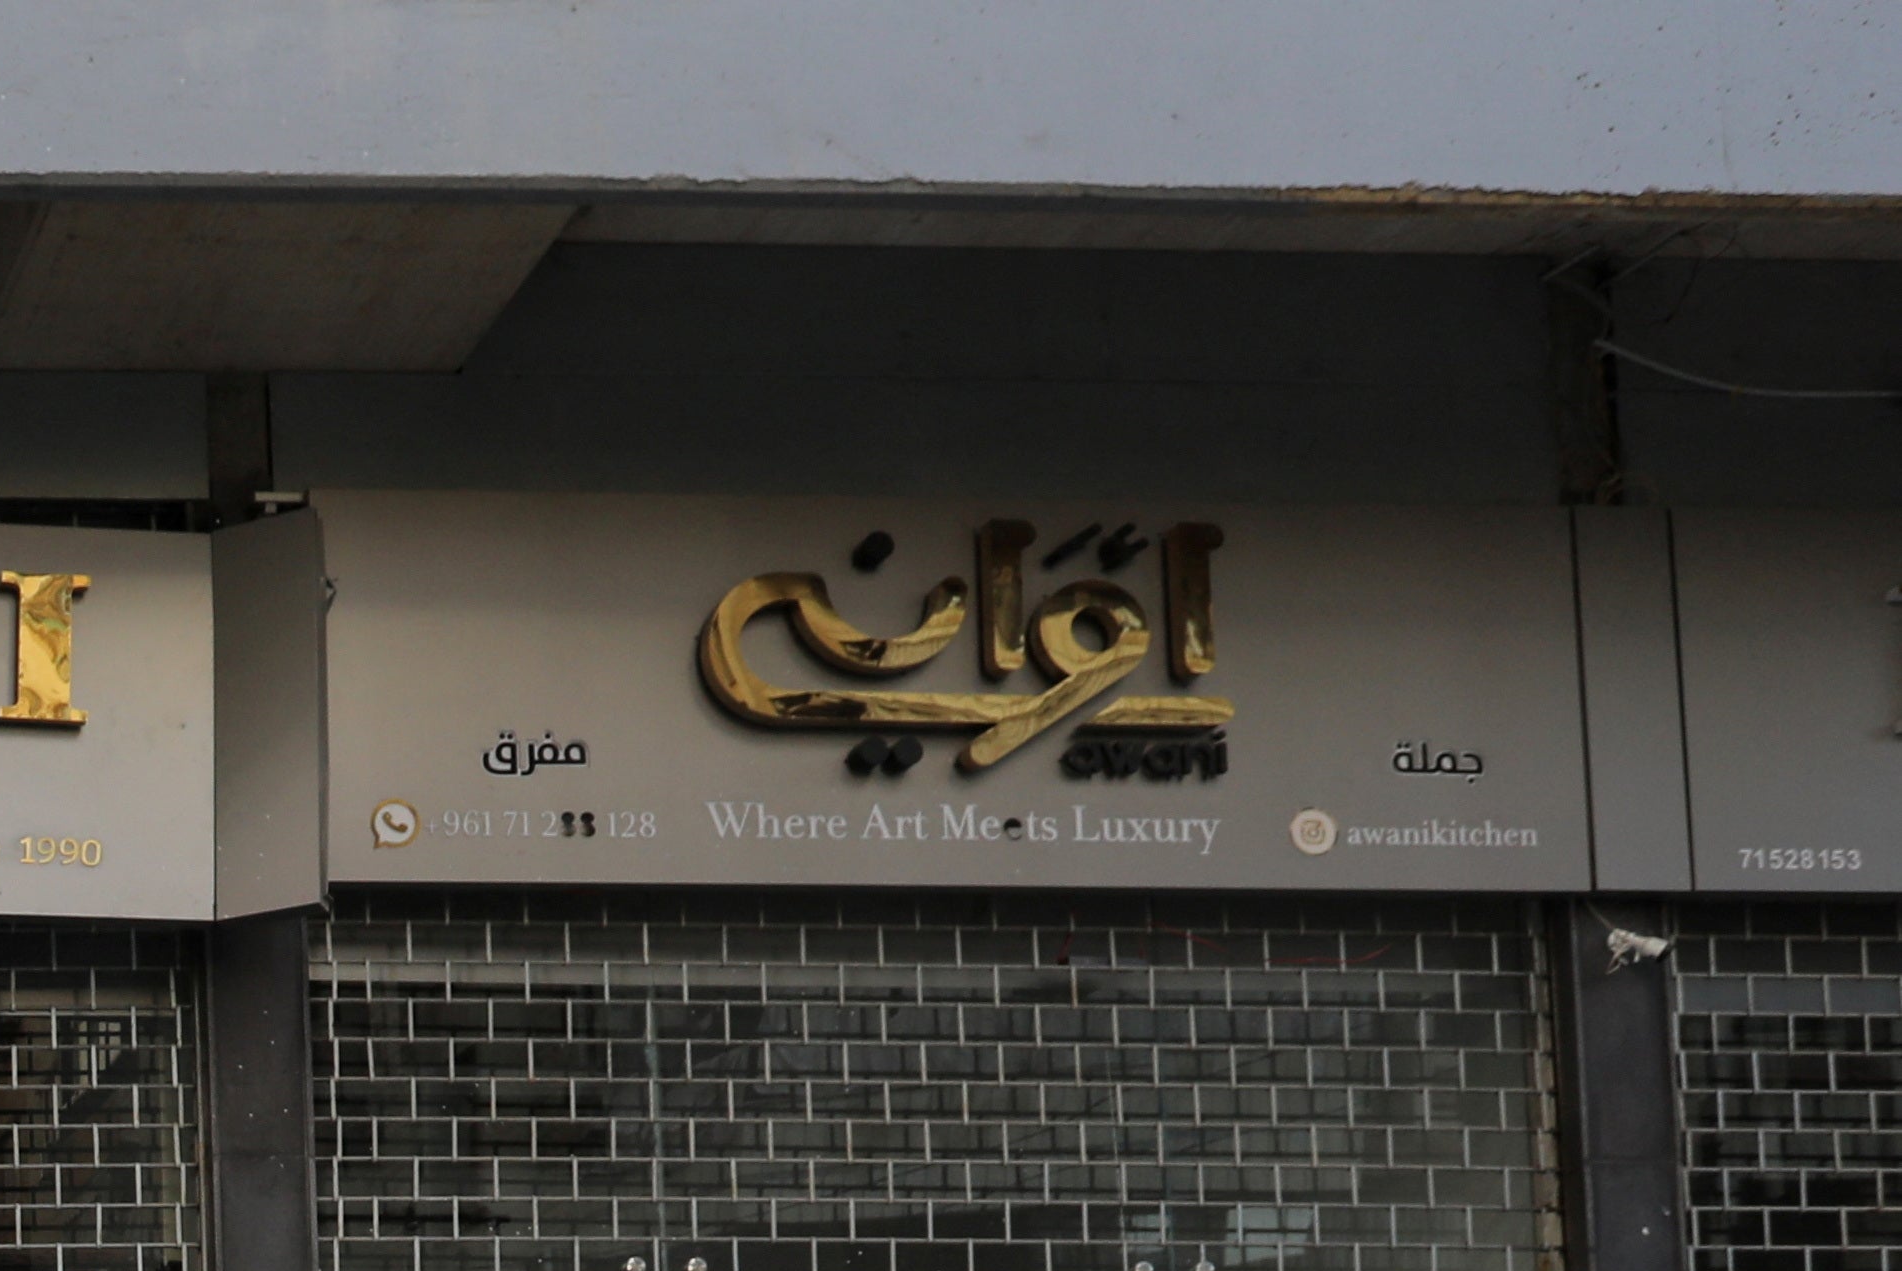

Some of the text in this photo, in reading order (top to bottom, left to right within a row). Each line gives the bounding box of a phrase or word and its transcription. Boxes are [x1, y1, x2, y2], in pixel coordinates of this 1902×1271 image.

[481, 730, 590, 776] مفرق
[1392, 739, 1485, 785] جملة
[502, 811, 532, 837] 71
[606, 812, 657, 839] 128
[706, 800, 1222, 855] Where Art Meets Luxury
[1346, 819, 1539, 847] awanikitchen
[19, 834, 104, 868] 1990
[1738, 848, 1863, 872] 71528153
